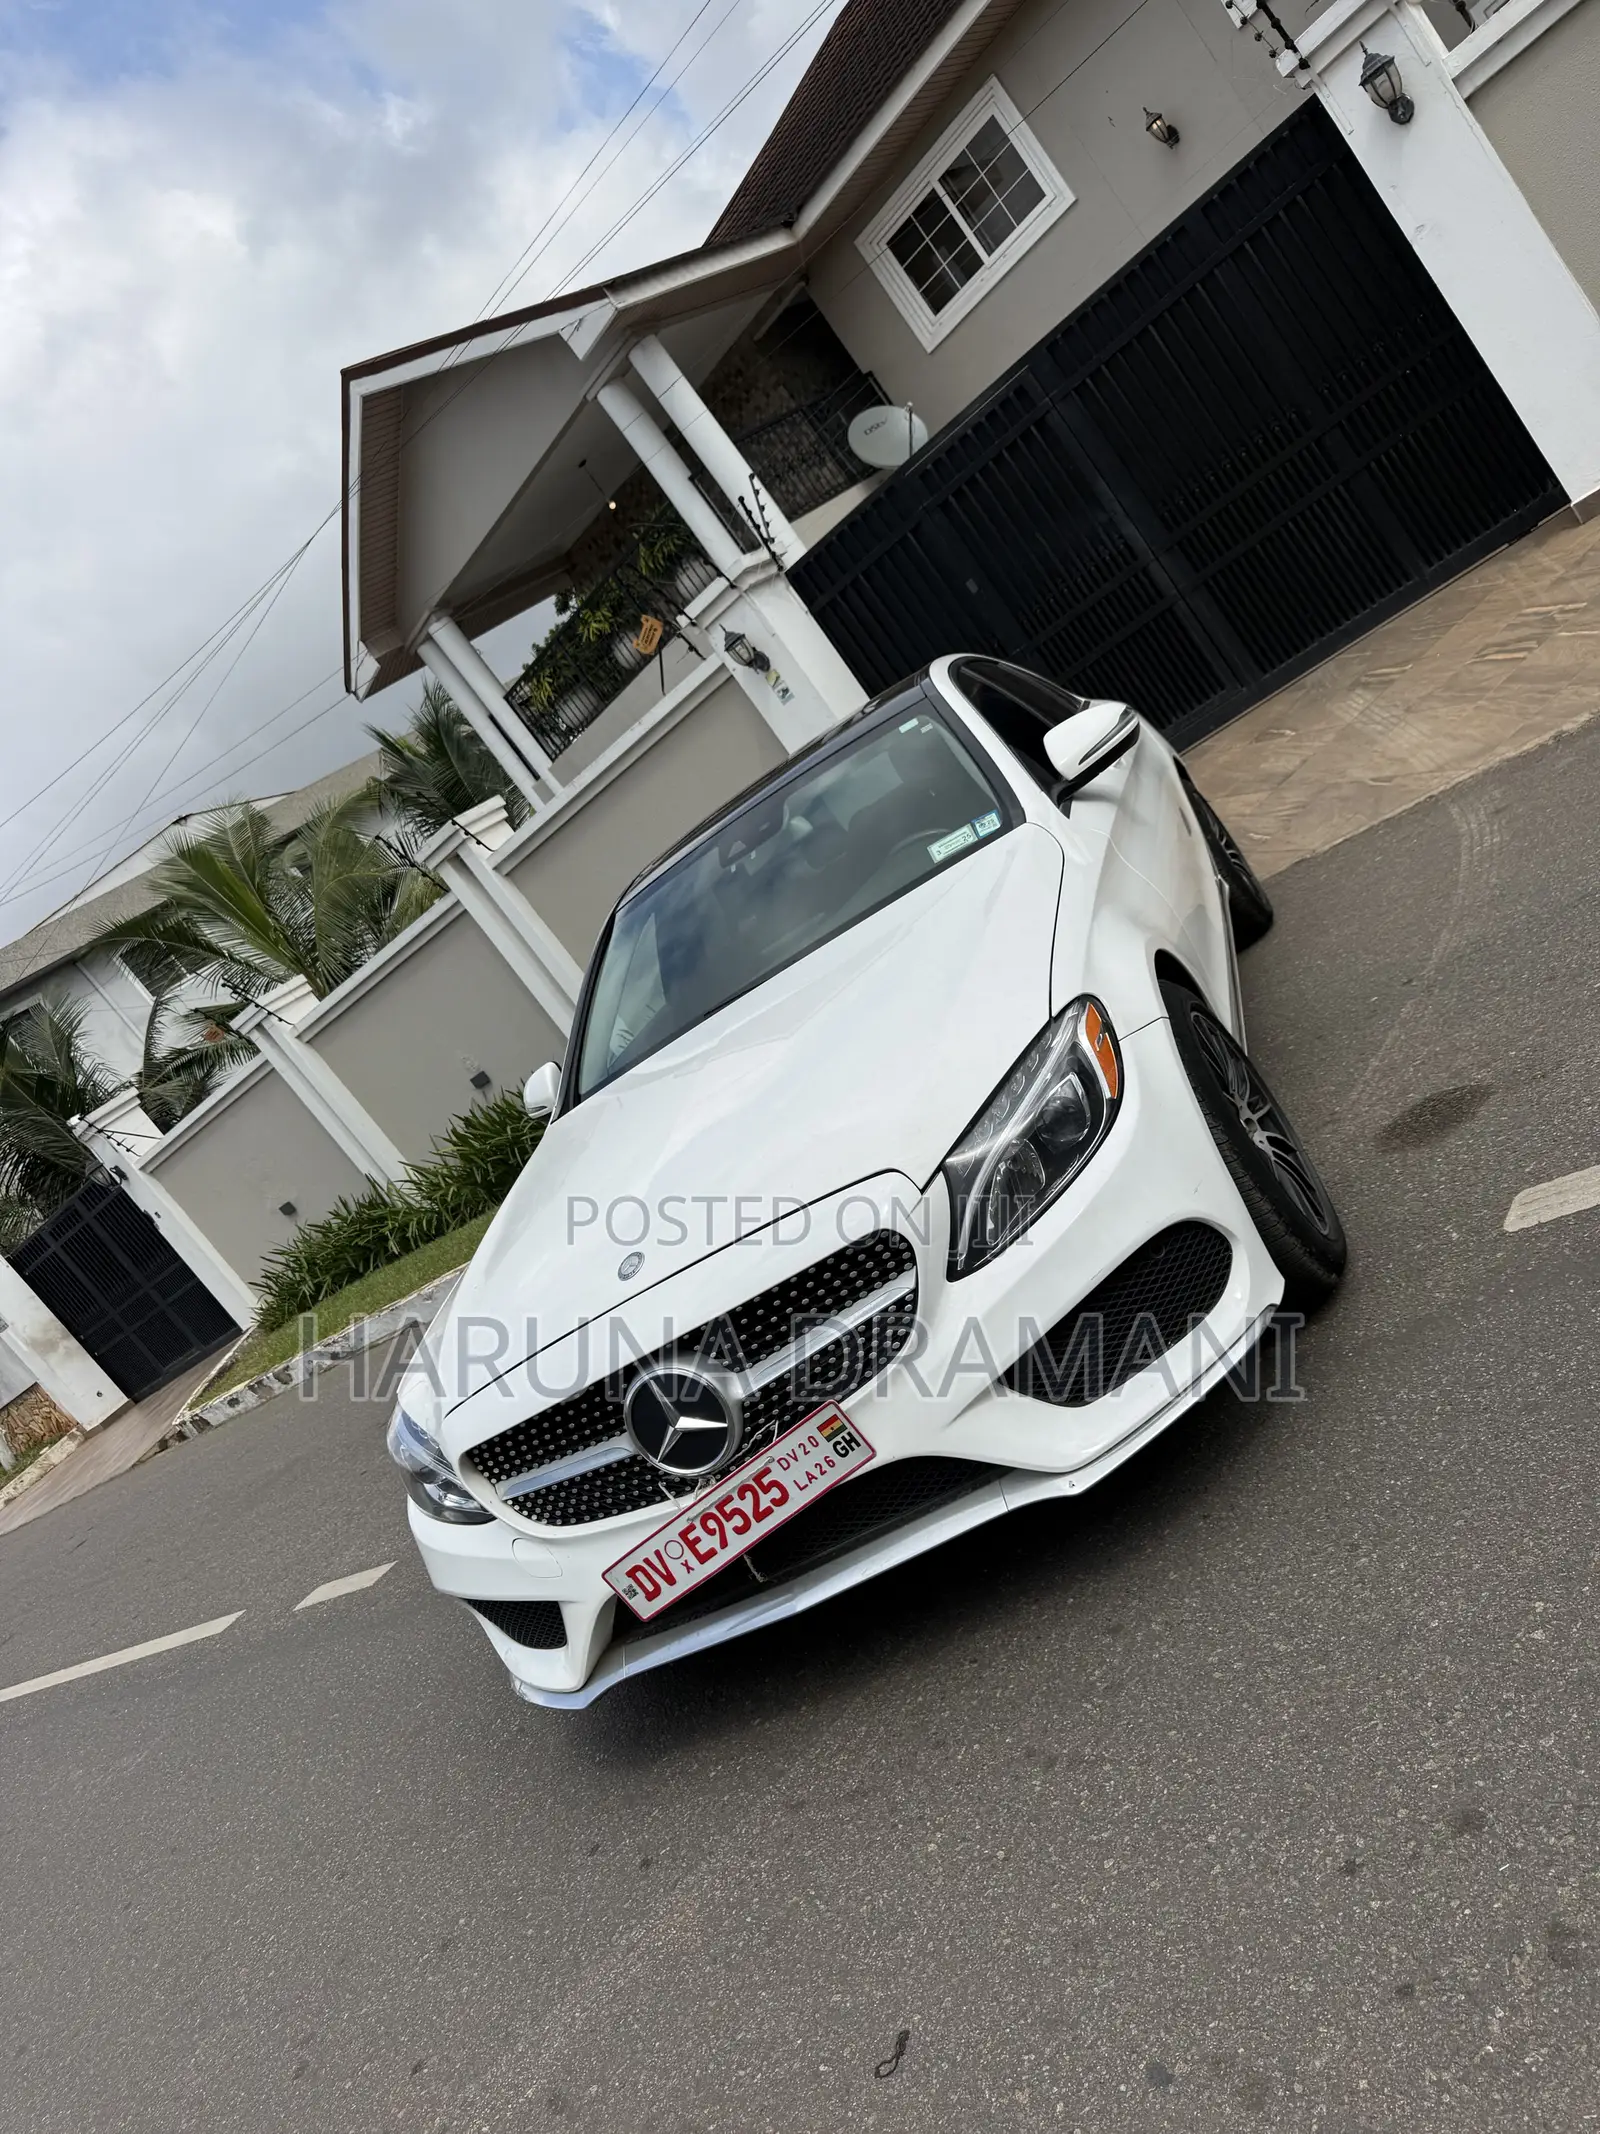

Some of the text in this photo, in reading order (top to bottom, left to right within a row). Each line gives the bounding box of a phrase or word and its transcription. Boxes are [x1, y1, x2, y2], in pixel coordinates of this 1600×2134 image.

[776, 1431, 861, 1471] DV20 GH
[793, 1455, 836, 1491] LA26
[625, 1466, 790, 1602] DV E9525
